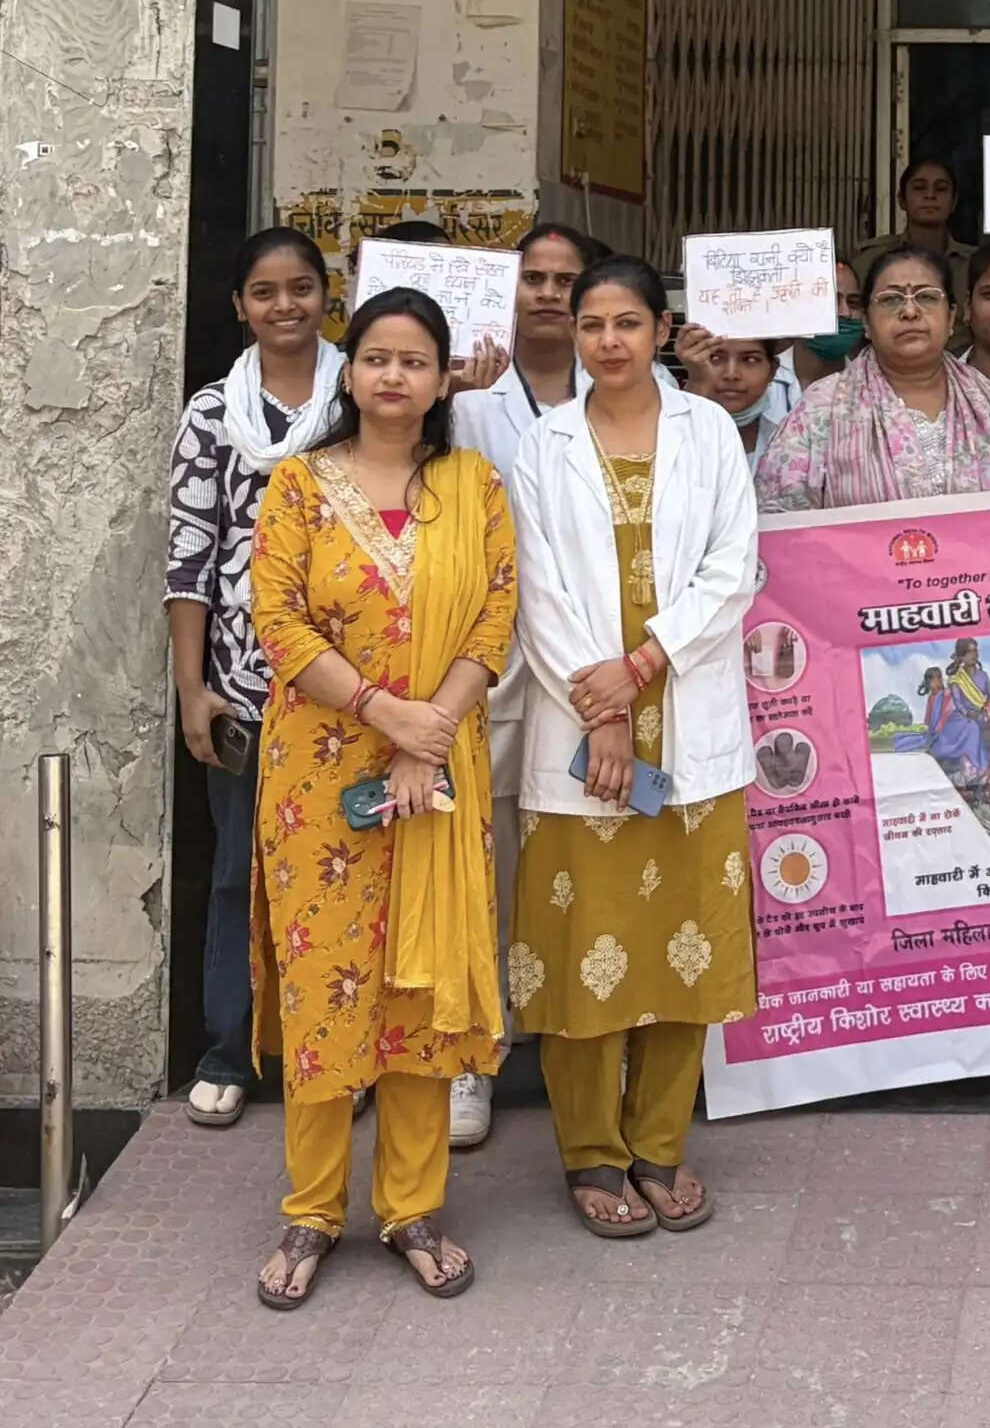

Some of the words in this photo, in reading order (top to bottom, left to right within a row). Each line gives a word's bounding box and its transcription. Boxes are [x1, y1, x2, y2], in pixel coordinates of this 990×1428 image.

[927, 572, 985, 589] together
[859, 589, 981, 634] माहवारी
[914, 868, 964, 887] माहवारी
[969, 864, 980, 879] में
[891, 928, 934, 952] जिला
[788, 979, 850, 1006] जानकारी
[856, 980, 873, 995] या
[880, 971, 936, 992] सहायता
[941, 965, 955, 982] के
[959, 961, 987, 980] लिए
[761, 1013, 823, 1045] राष्ट्रीय
[831, 1007, 892, 1033] किशोर
[899, 996, 968, 1022] स्वास्थ्य
